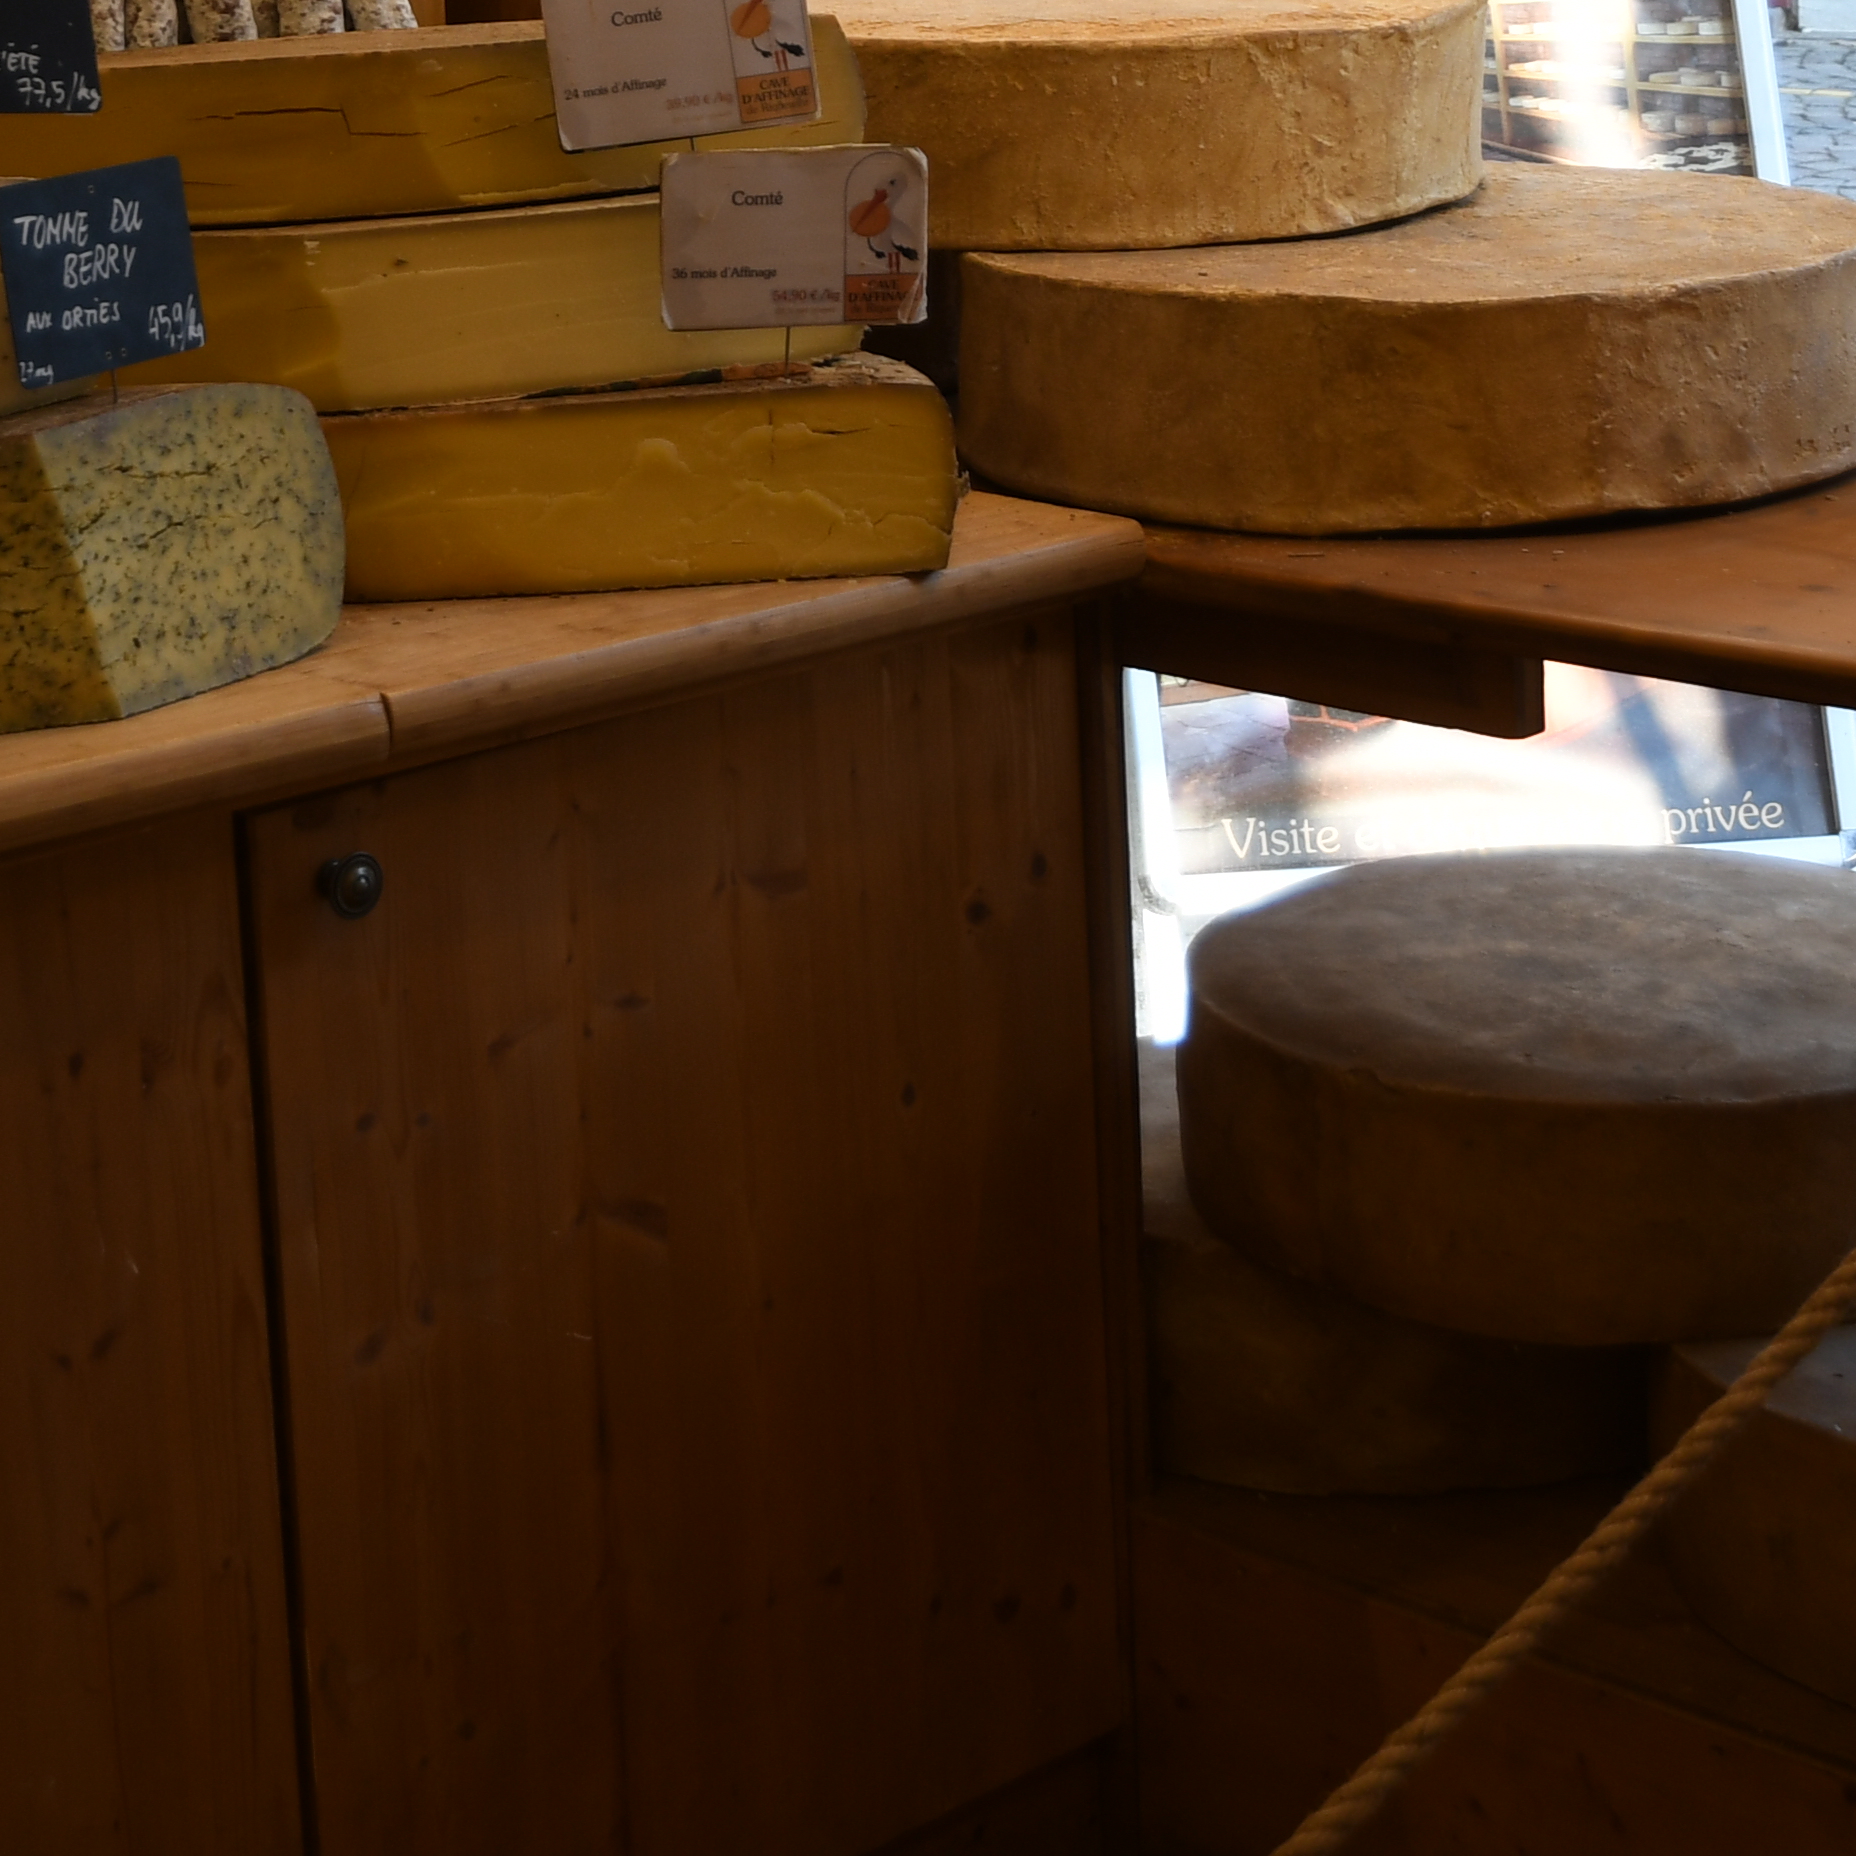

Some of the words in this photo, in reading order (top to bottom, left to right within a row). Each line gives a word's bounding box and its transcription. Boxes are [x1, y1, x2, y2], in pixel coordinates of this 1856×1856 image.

[611, 7, 663, 27] Comté
[564, 88, 579, 101] 24
[582, 84, 609, 98] mois
[731, 190, 783, 207] Comté
[13, 209, 89, 249] TOMME
[109, 197, 143, 234] DU
[63, 243, 137, 289] BERRY
[672, 267, 687, 280] 36
[691, 268, 717, 279] mois
[720, 266, 777, 281] d'Affinage
[1222, 817, 1341, 859] Visite
[1661, 791, 1786, 844] privée
